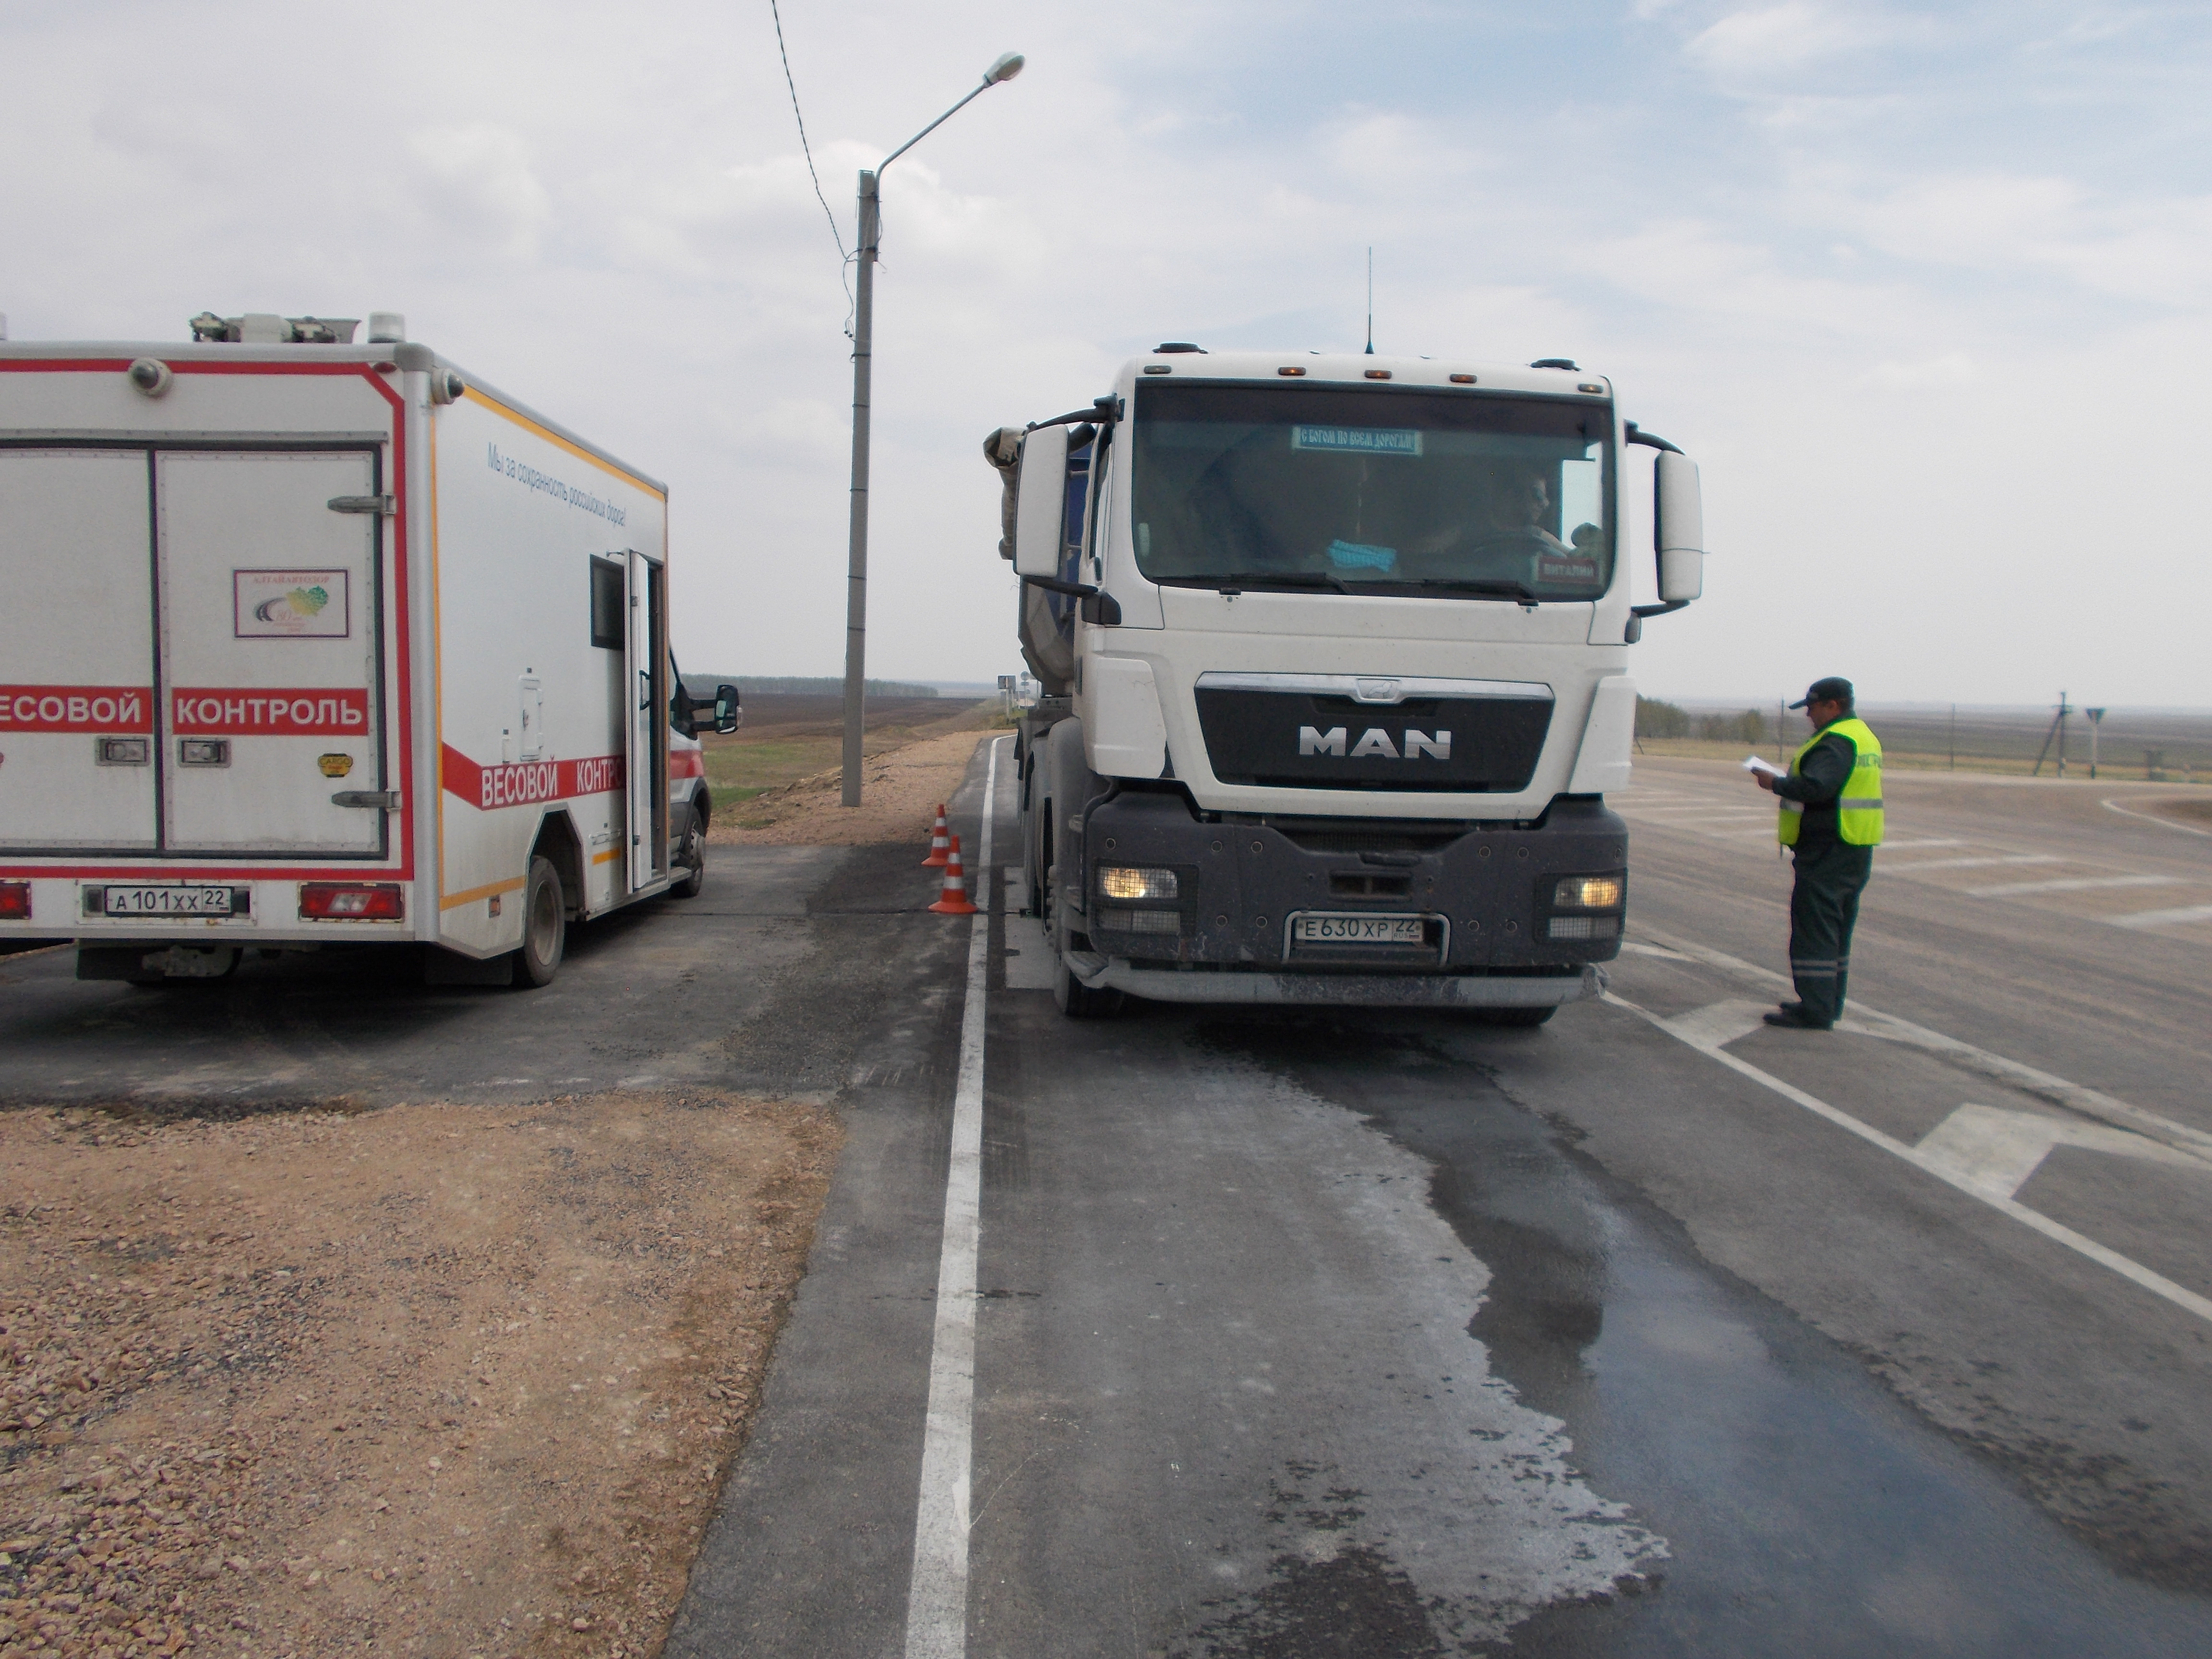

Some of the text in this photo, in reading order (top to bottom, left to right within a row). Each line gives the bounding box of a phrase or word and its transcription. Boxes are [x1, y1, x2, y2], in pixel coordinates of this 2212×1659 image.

[1309, 429, 1335, 444] БОГОМ
[1338, 431, 1348, 445] ПО
[1350, 432, 1372, 446] ВСЕМ
[488, 442, 626, 528] Мы за сохранность российских дорог!
[176, 698, 362, 725] КОНТРОЛЬ
[1299, 726, 1452, 760] MAN
[481, 755, 557, 807] ВЕСОВОЙ
